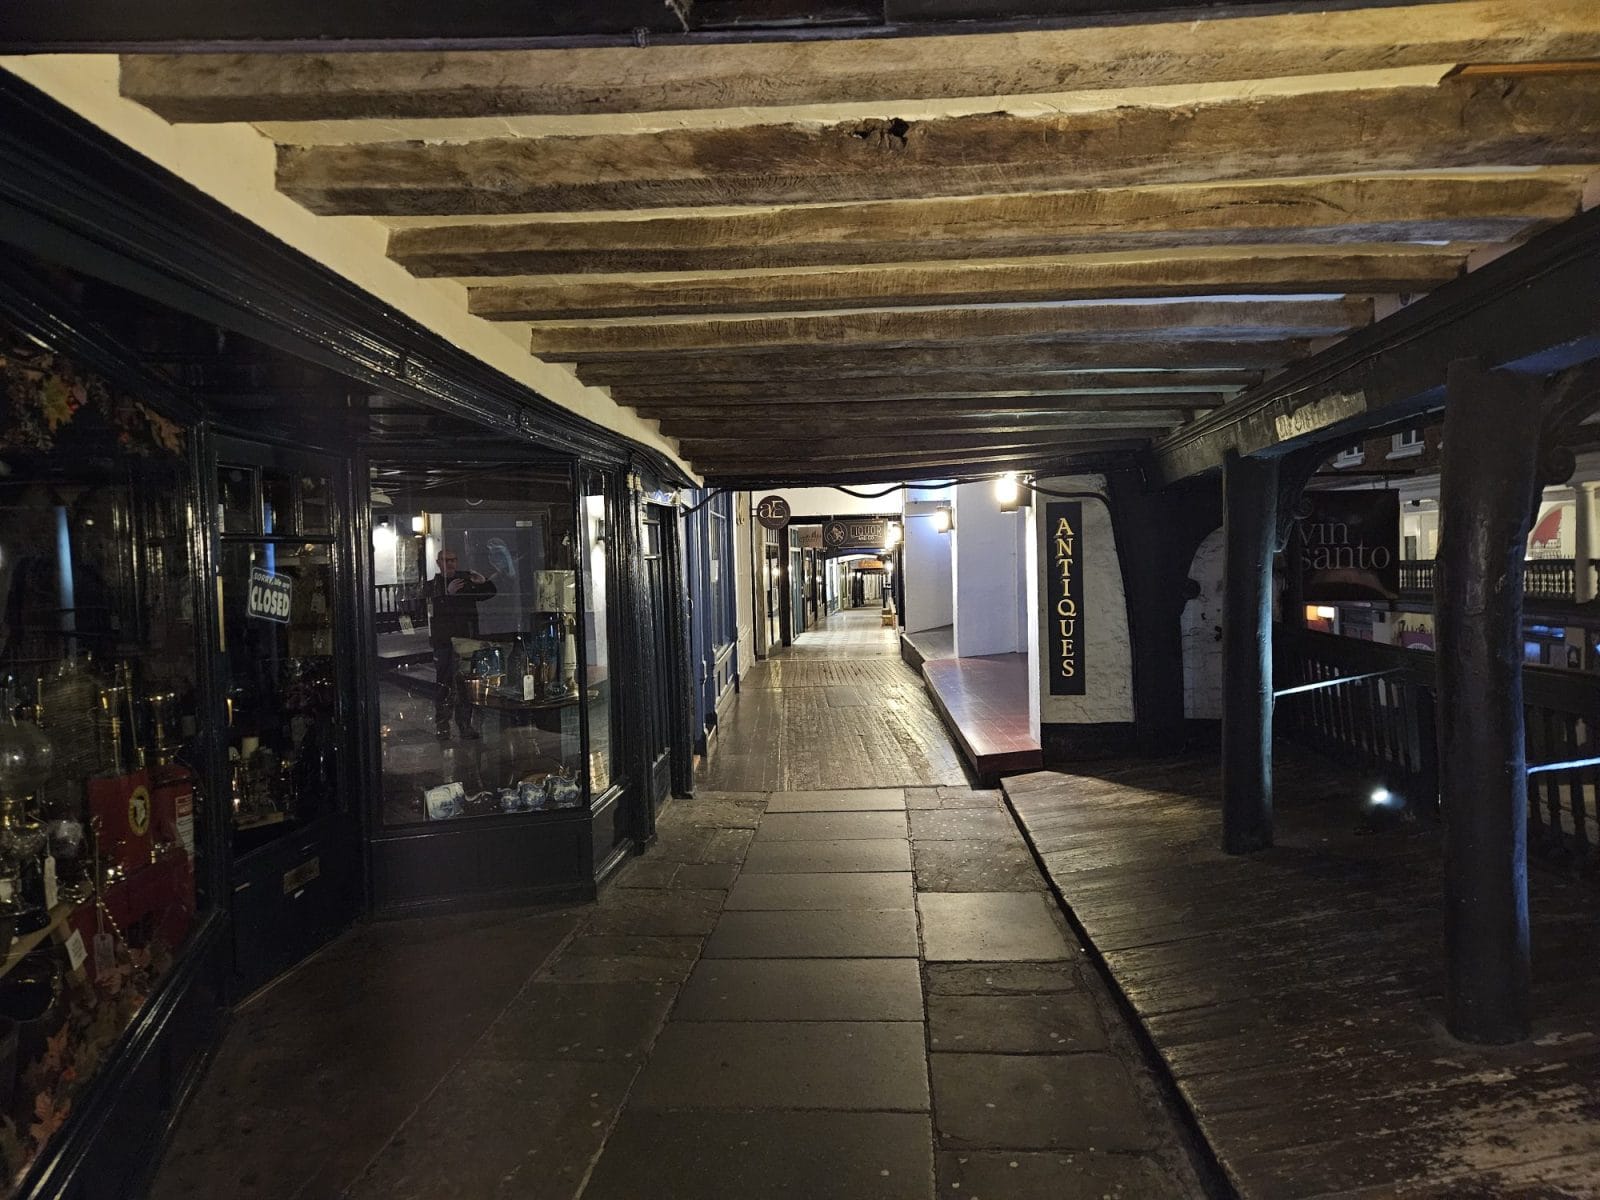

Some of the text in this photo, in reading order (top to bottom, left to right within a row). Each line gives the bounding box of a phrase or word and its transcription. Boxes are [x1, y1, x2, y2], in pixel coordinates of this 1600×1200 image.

[851, 524, 883, 538] LIQUOR
[1299, 522, 1352, 546] vin
[1301, 537, 1391, 570] santo
[251, 585, 290, 617] CLOSED
[1056, 517, 1077, 677] ANTIQUES
